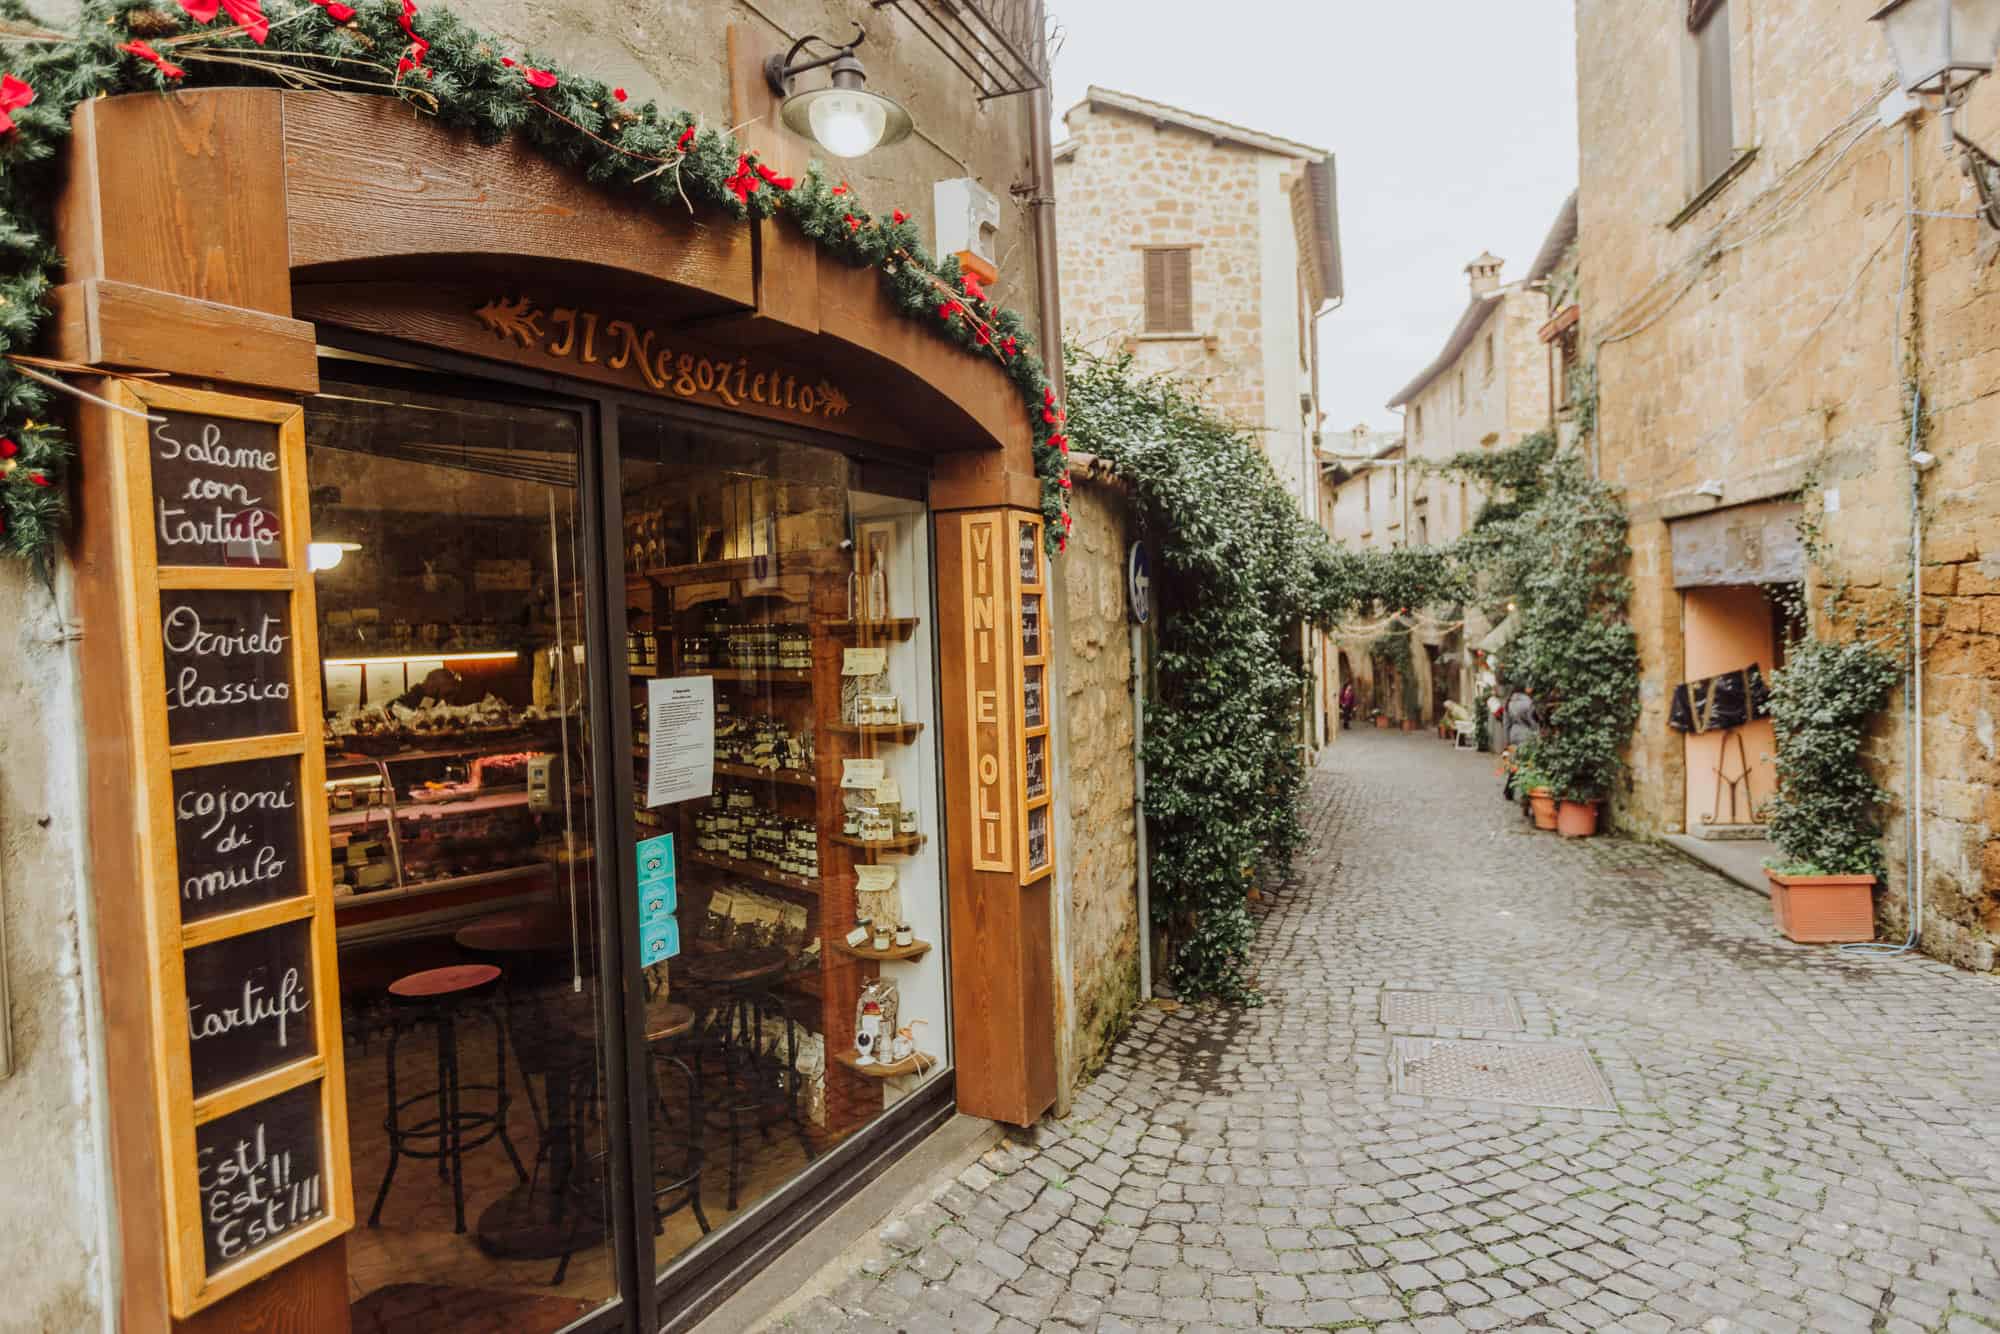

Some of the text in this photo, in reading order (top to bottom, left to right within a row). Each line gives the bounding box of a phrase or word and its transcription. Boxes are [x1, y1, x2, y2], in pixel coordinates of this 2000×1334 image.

[607, 320, 816, 416] Negozietto
[155, 423, 281, 472] Salame
[183, 477, 262, 506] con
[159, 498, 281, 566] tartufo
[163, 606, 291, 657] Orvieto
[971, 527, 1001, 855] VINI E OLI
[216, 824, 254, 853] di
[184, 846, 287, 899] mulo
